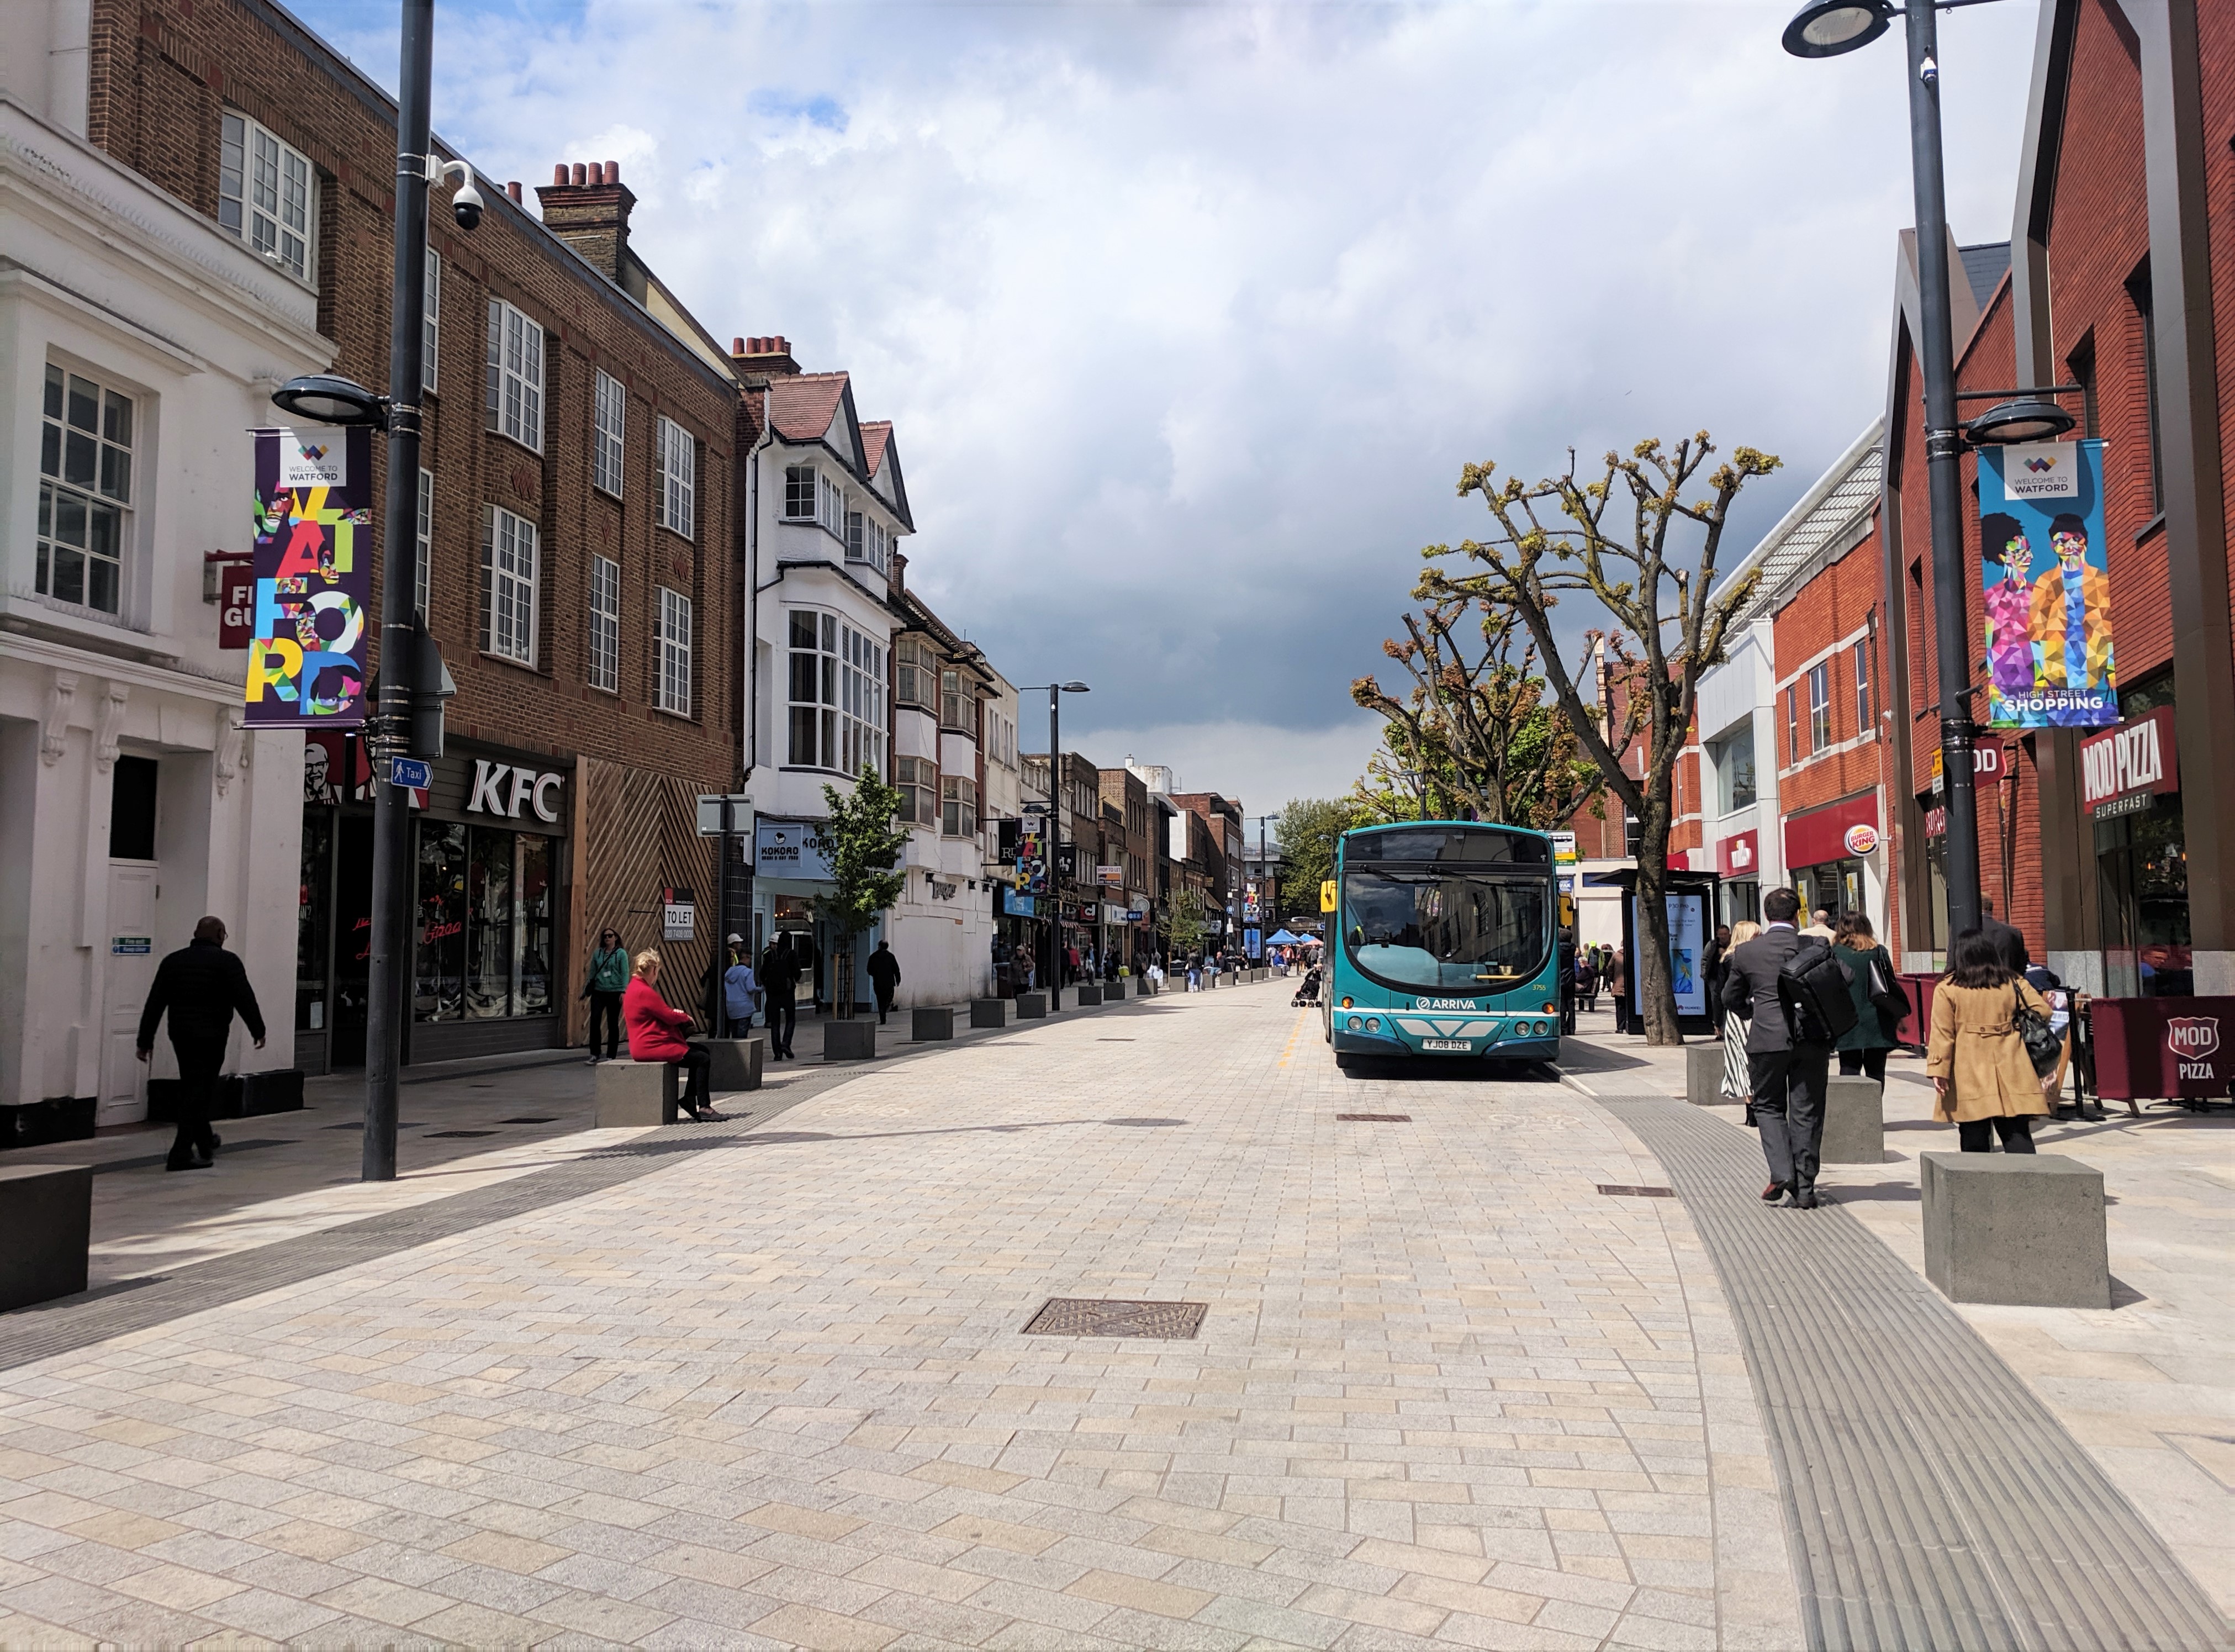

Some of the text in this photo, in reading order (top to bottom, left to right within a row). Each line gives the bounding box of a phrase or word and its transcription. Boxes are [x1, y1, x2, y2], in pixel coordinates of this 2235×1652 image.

[289, 473, 338, 481] WATFORD
[2015, 477, 2054, 485] WELCOME
[2015, 484, 2068, 493] WATFORD
[2019, 689, 2088, 699] HIGH STREET
[2004, 696, 2104, 712] SHOPPING
[1974, 748, 1997, 773] OD
[2083, 719, 2163, 802] MOD PIZZA
[406, 767, 422, 780] Taxi
[467, 758, 562, 822] KFC
[2096, 794, 2147, 819] SUPERFAST
[1851, 831, 1874, 842] BURGER
[1852, 836, 1875, 849] KING
[761, 846, 799, 855] KOKORO
[667, 911, 692, 924] TO LET
[1431, 999, 1477, 1010] ARRIVA
[2174, 1026, 2212, 1046] MOD
[1426, 1040, 1467, 1049] YJ08 DZE
[2179, 1063, 2215, 1080] PIZZA
